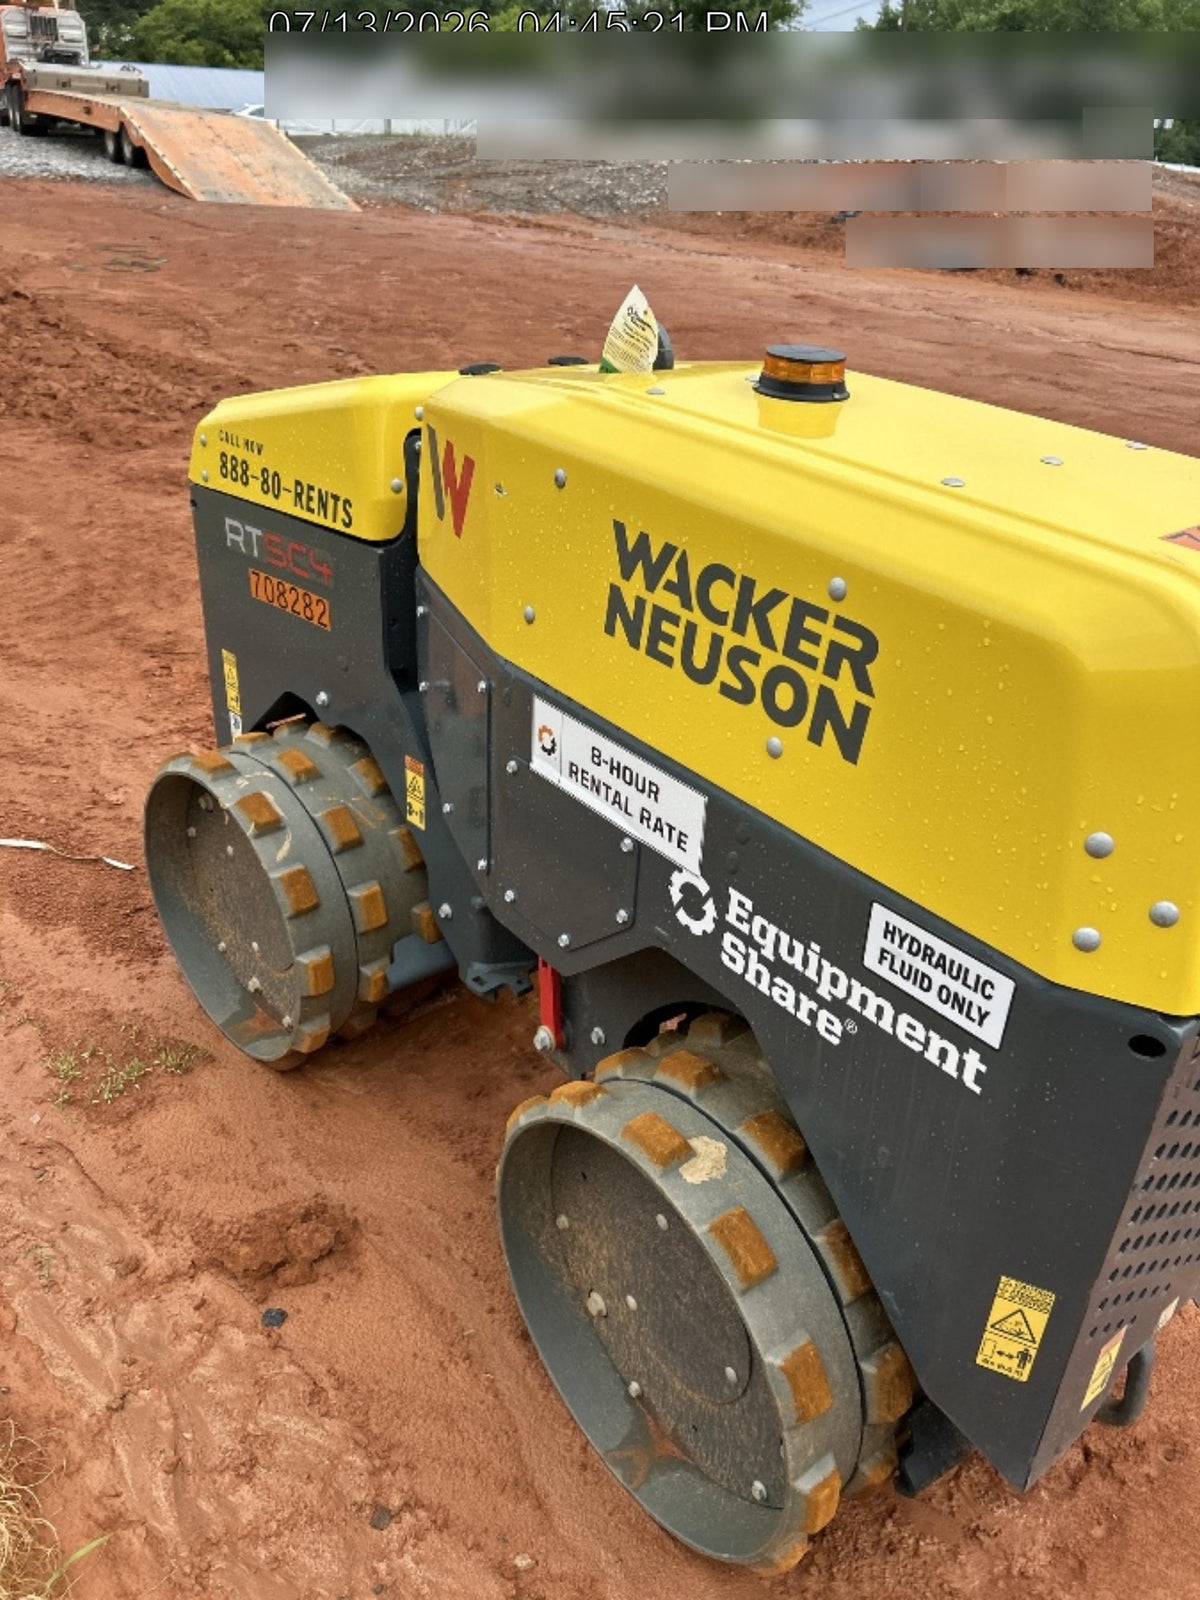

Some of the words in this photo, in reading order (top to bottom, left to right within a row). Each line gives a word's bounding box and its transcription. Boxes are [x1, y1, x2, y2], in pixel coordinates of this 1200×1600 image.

[219, 429, 241, 449] CALL
[219, 451, 353, 529] 888-80-RENTS
[251, 570, 328, 628] 708282
[612, 518, 880, 699] WACKER
[604, 582, 872, 766] NEUSON
[568, 761, 633, 817] RENTAL
[639, 806, 689, 853] RATE
[724, 886, 988, 1095] Equipment
[877, 946, 932, 994] FLUID
[937, 981, 991, 1029] ONLY
[883, 920, 995, 1001] HYDRAULIC
